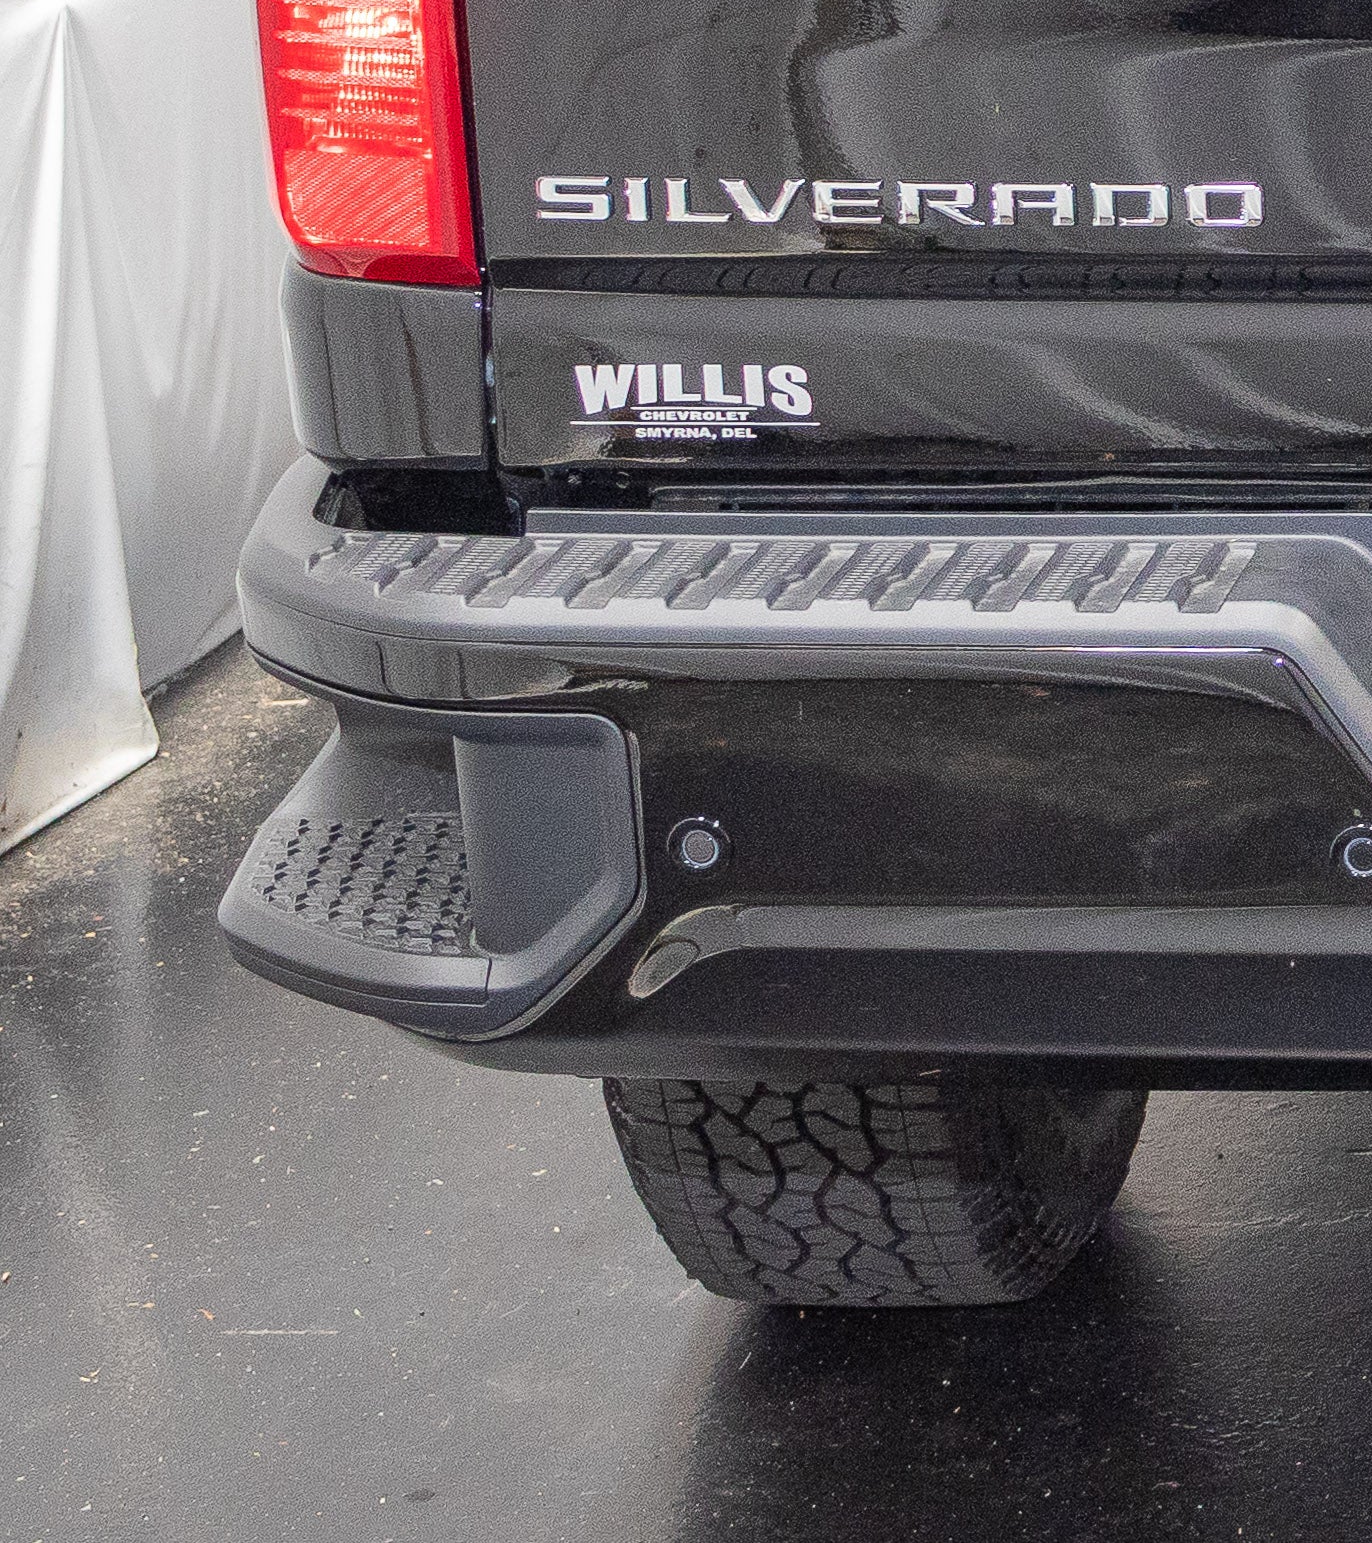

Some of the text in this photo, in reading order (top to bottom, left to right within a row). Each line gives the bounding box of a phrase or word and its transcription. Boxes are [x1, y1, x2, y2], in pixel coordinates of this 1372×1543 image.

[535, 175, 1265, 227] SILVERADO
[573, 363, 814, 417] WILLIS
[639, 410, 750, 422] CHEVROLET
[634, 427, 758, 440] SMYRNA, DEL
